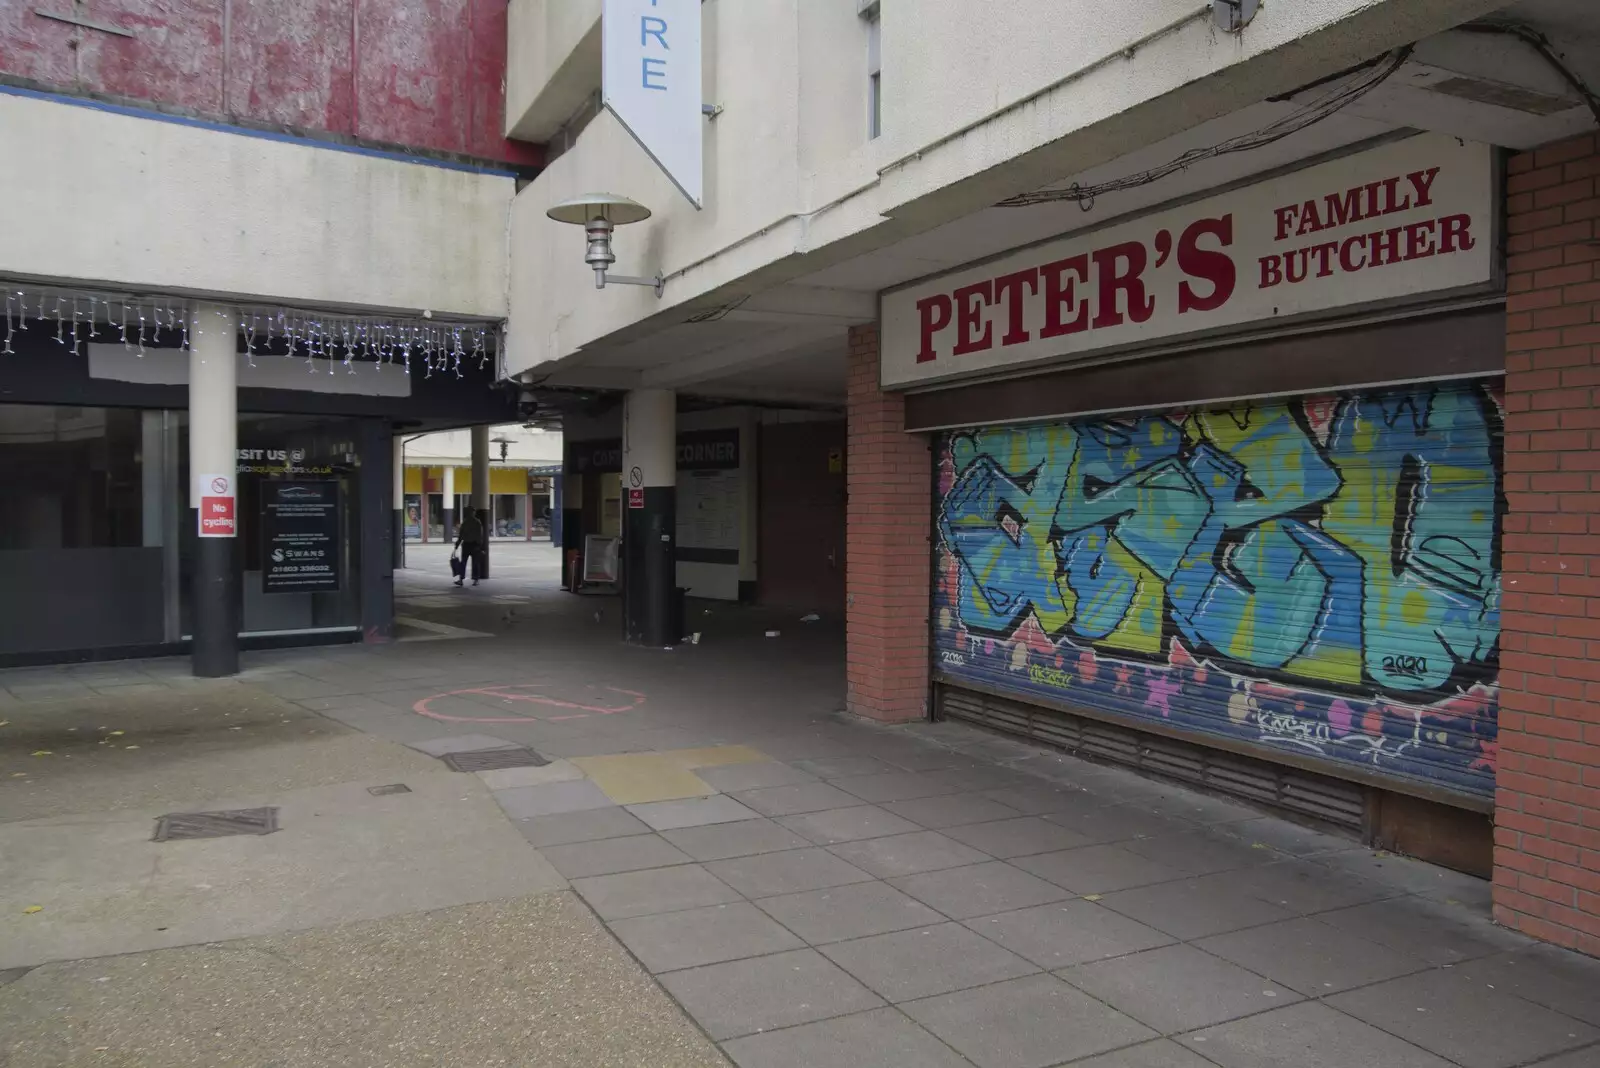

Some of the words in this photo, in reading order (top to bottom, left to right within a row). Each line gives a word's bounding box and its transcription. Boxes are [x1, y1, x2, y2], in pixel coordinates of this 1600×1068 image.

[641, 0, 669, 90] RE
[1273, 166, 1440, 241] FAMILY
[1258, 213, 1475, 289] BUTCHER
[916, 213, 1236, 364] PETER'S
[236, 449, 264, 460] ISIT
[267, 449, 287, 460] US
[676, 441, 735, 463] CORNER
[212, 503, 226, 513] No
[203, 516, 233, 528] cycling
[1382, 654, 1428, 674] 2020
